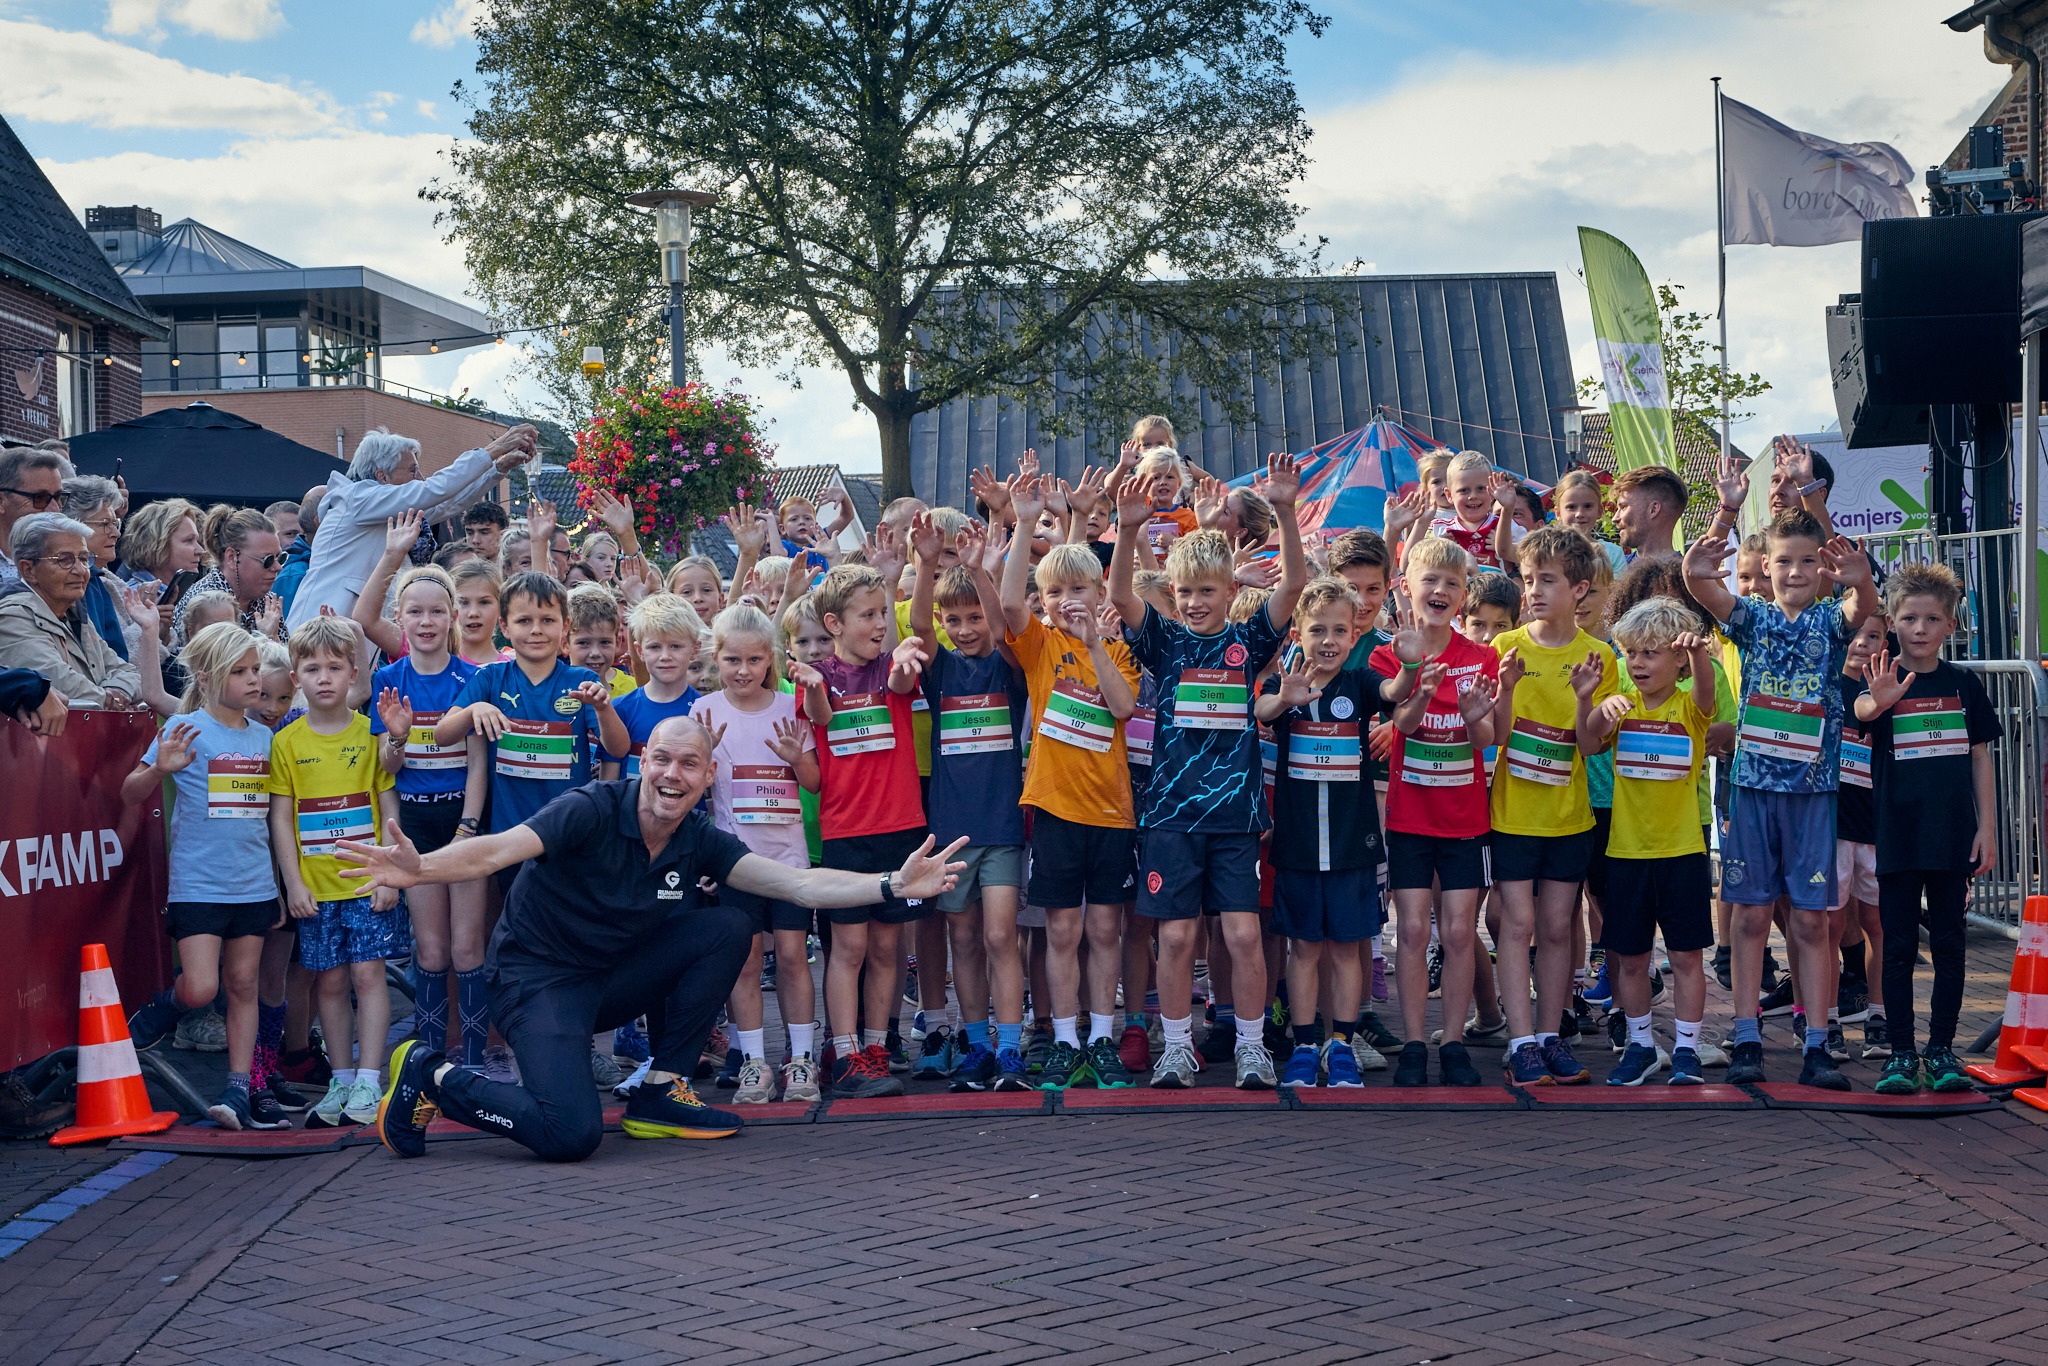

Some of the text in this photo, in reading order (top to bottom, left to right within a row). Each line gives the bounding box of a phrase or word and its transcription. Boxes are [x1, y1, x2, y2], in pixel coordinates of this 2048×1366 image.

[1911, 512, 1929, 520] voo
[1200, 689, 1225, 699] Siem
[1207, 703, 1217, 711] 92
[1067, 704, 1097, 720] Joppe
[850, 715, 873, 725] Mika
[962, 716, 991, 725] Jesse
[1071, 719, 1086, 729] 107
[1923, 718, 1943, 728] Stijn
[855, 727, 870, 736] 101
[971, 728, 982, 736] 97
[1774, 731, 1789, 741] 190
[1928, 731, 1942, 739] 100
[425, 745, 440, 753] 163
[517, 740, 548, 750] Jonas
[1313, 743, 1332, 752] Jim
[1424, 748, 1453, 758] Hidde
[1536, 743, 1559, 757] Bent
[1840, 748, 1868, 760] erencz
[526, 753, 537, 761] 94
[1314, 756, 1330, 764] 112
[1644, 753, 1660, 762] 180
[1433, 762, 1442, 770] 91
[1537, 758, 1552, 767] 102
[1841, 758, 1855, 768] 170
[232, 780, 264, 792] Daantje
[756, 786, 786, 795] Philou
[765, 799, 779, 807] 155
[323, 816, 348, 827] John
[329, 829, 345, 837] 133
[484, 1112, 513, 1129] CRAFT
